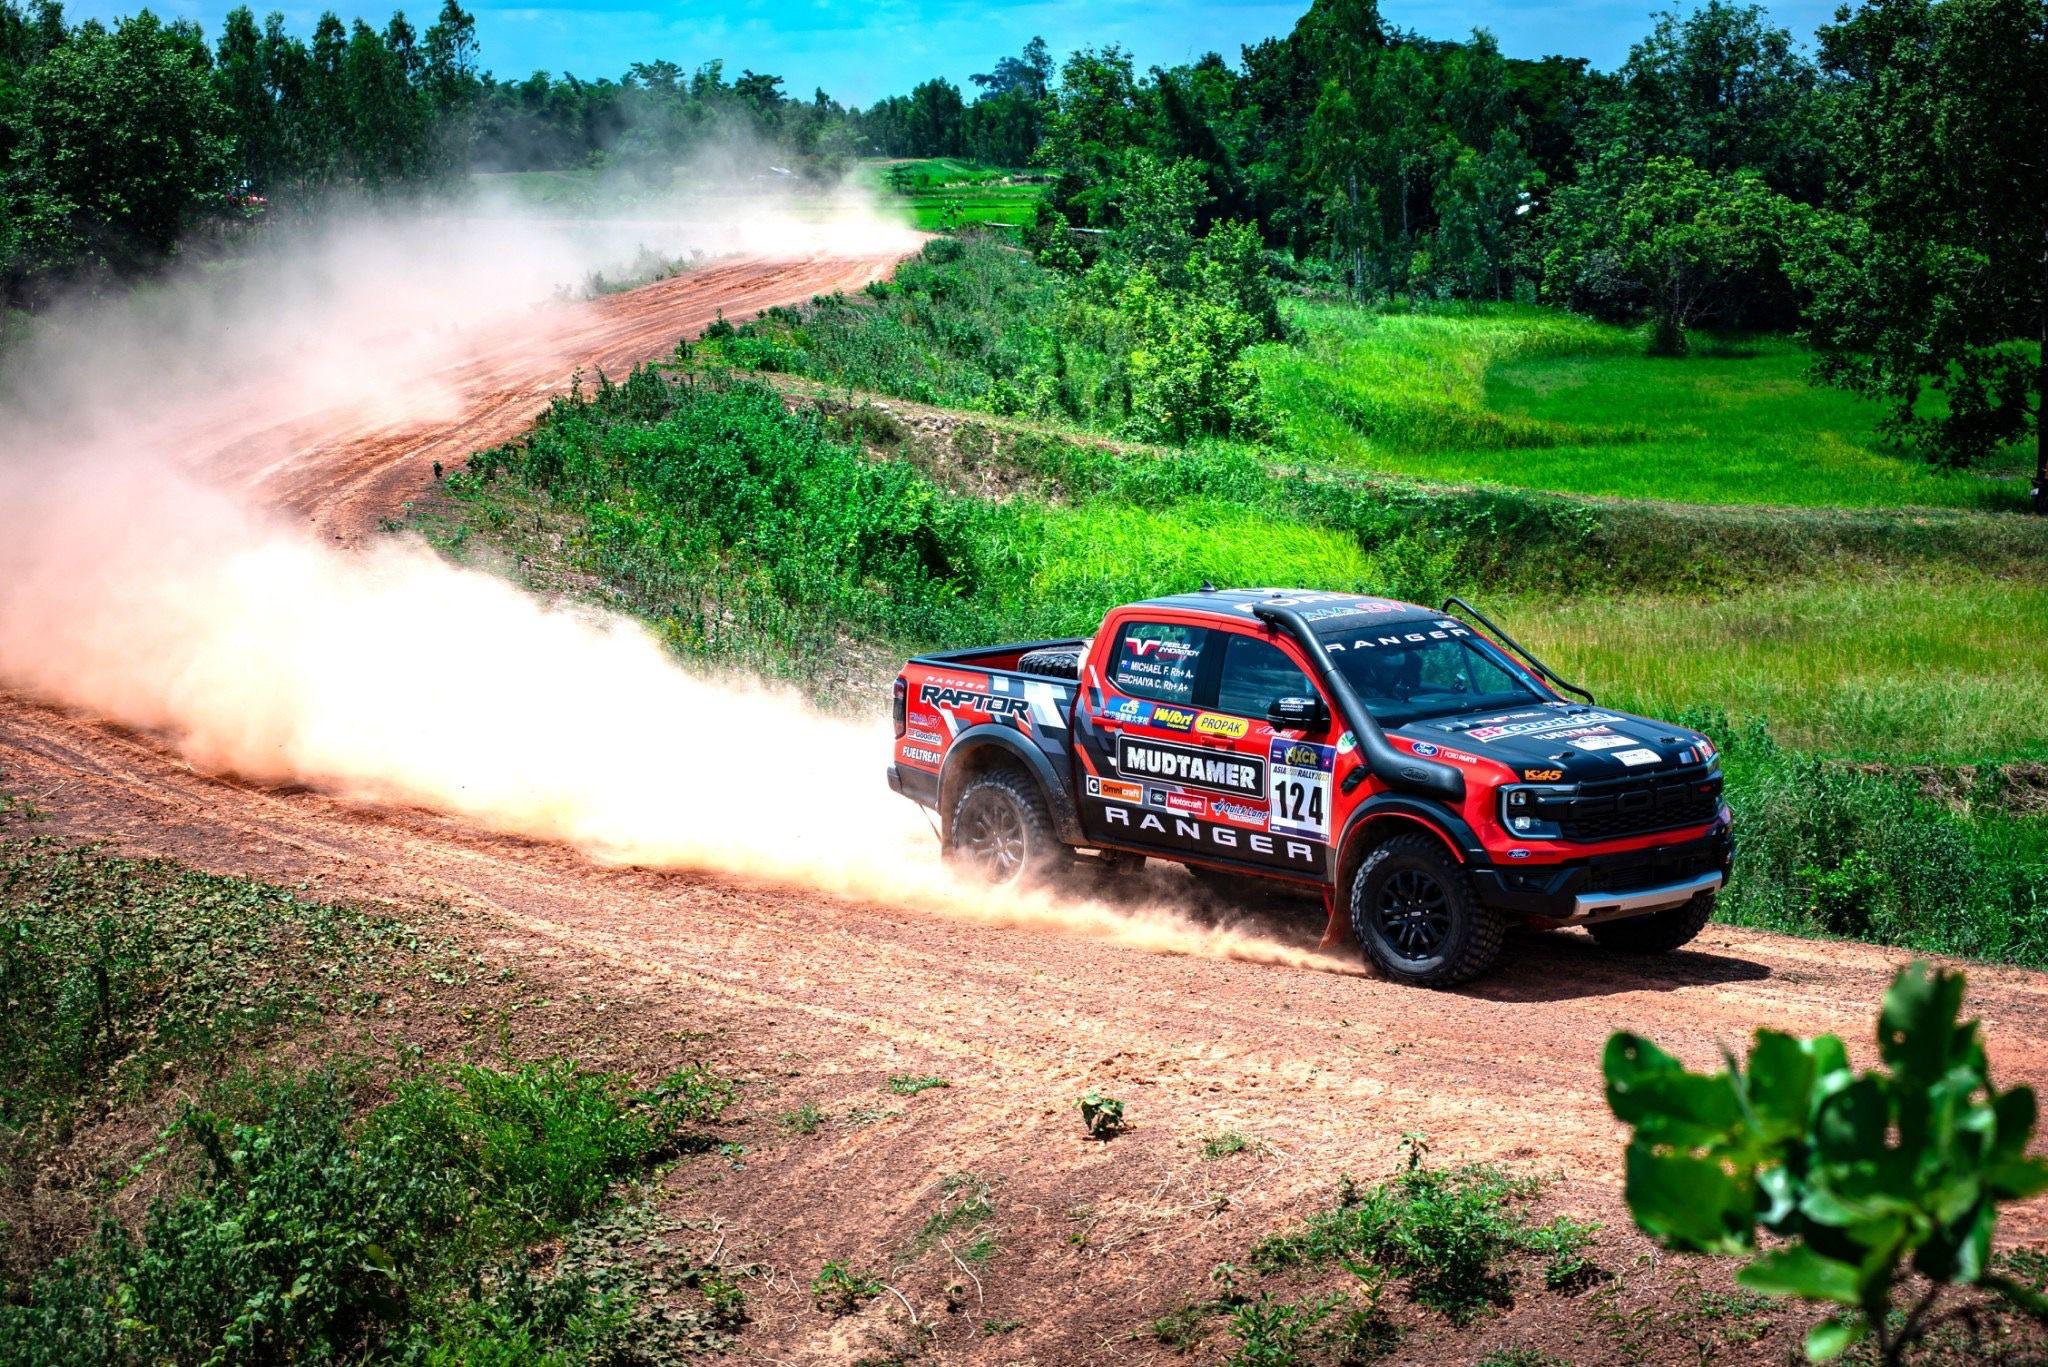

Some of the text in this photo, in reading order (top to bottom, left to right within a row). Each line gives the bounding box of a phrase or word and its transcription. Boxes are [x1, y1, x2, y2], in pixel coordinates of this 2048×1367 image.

[1325, 628, 1471, 653] RANGER
[1130, 660, 1194, 680] MICHAEL F. Rh+ A-
[926, 675, 986, 690] RANGER
[1127, 674, 1188, 692] CHAIYA C. Rh+ A+
[920, 683, 1033, 730] RAPTOR
[1200, 716, 1242, 735] PROPAK
[902, 746, 941, 764] FUELTREAT
[1443, 751, 1458, 761] FORD
[1127, 746, 1256, 790] MUDTAMER
[1273, 766, 1287, 775] ASIA
[1297, 769, 1316, 780] RALLY
[1524, 769, 1564, 782] K45
[1102, 783, 1141, 798] Omnicraft
[1170, 796, 1203, 810] Motorcraft
[1224, 802, 1247, 816] Quick
[1247, 806, 1268, 819] Lane
[1275, 780, 1324, 826] 124
[1105, 806, 1313, 862] RANGER
